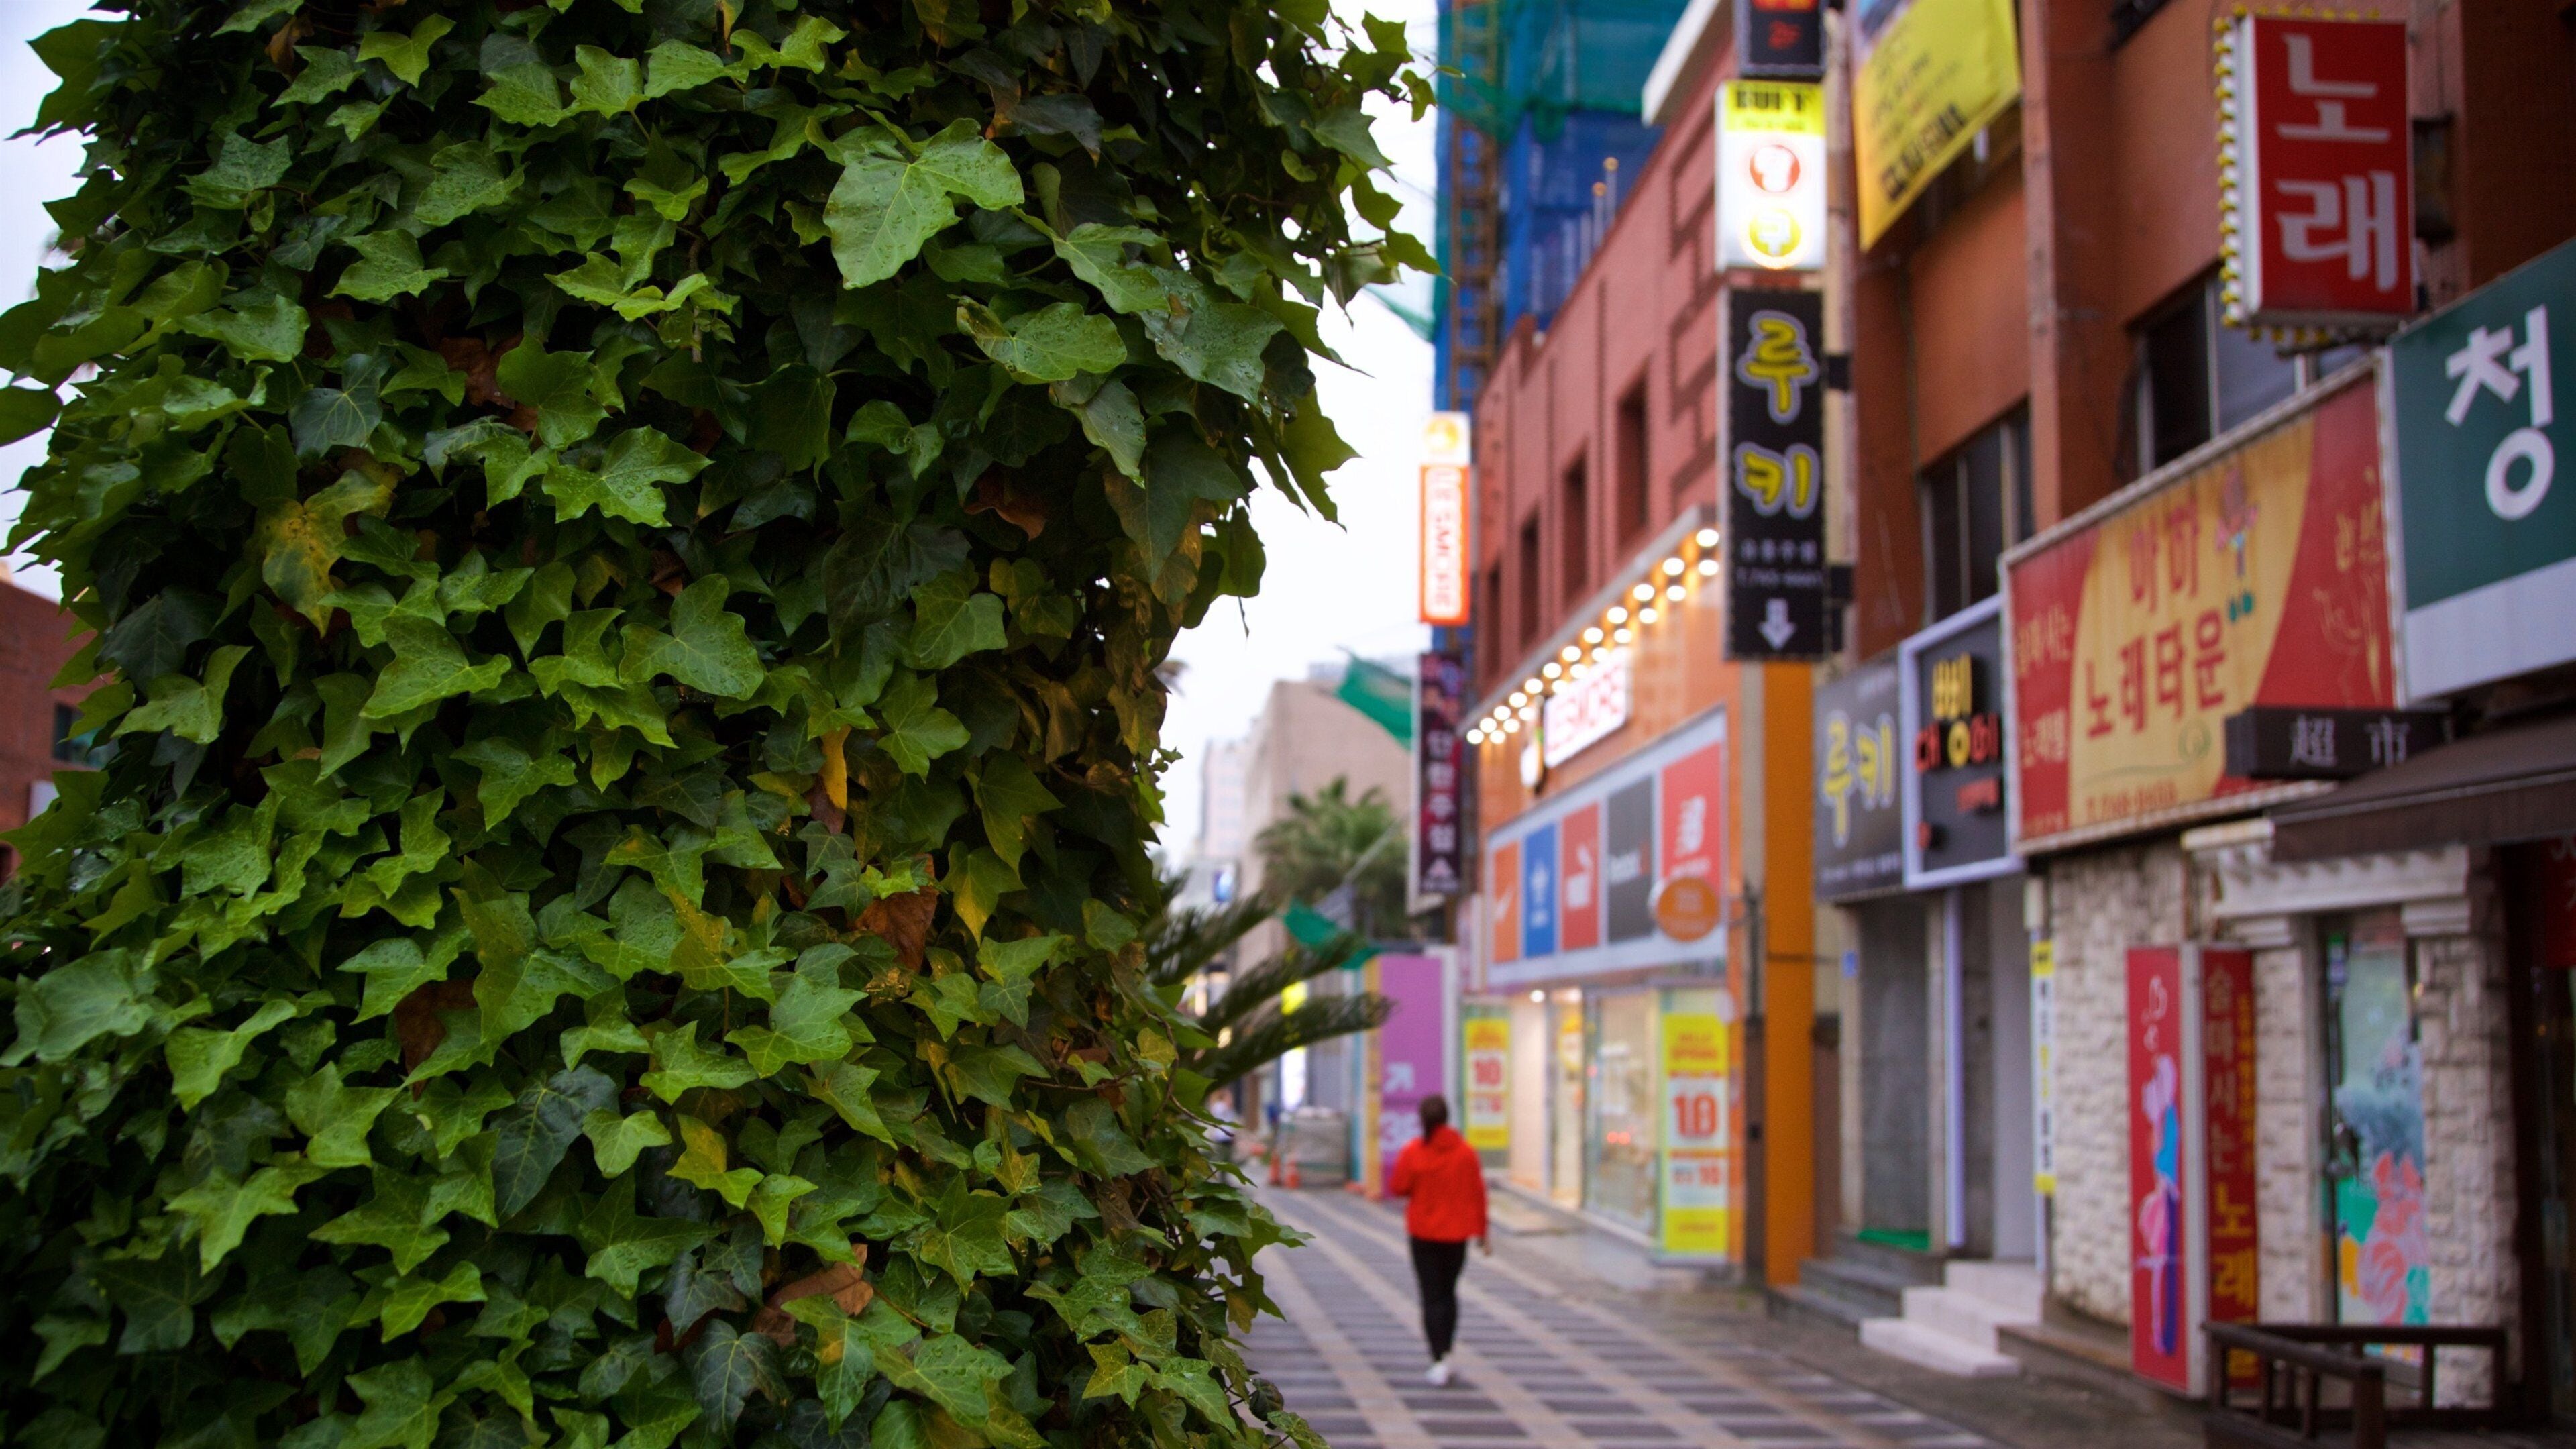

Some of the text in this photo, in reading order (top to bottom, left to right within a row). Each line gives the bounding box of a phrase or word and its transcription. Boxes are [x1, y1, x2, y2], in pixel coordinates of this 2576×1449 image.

[2275, 32, 2399, 292] 노래
[1743, 315, 1814, 511] 루키
[2444, 303, 2555, 521] 청
[2085, 609, 2226, 741] 노래타운
[1821, 711, 1895, 847] 루키
